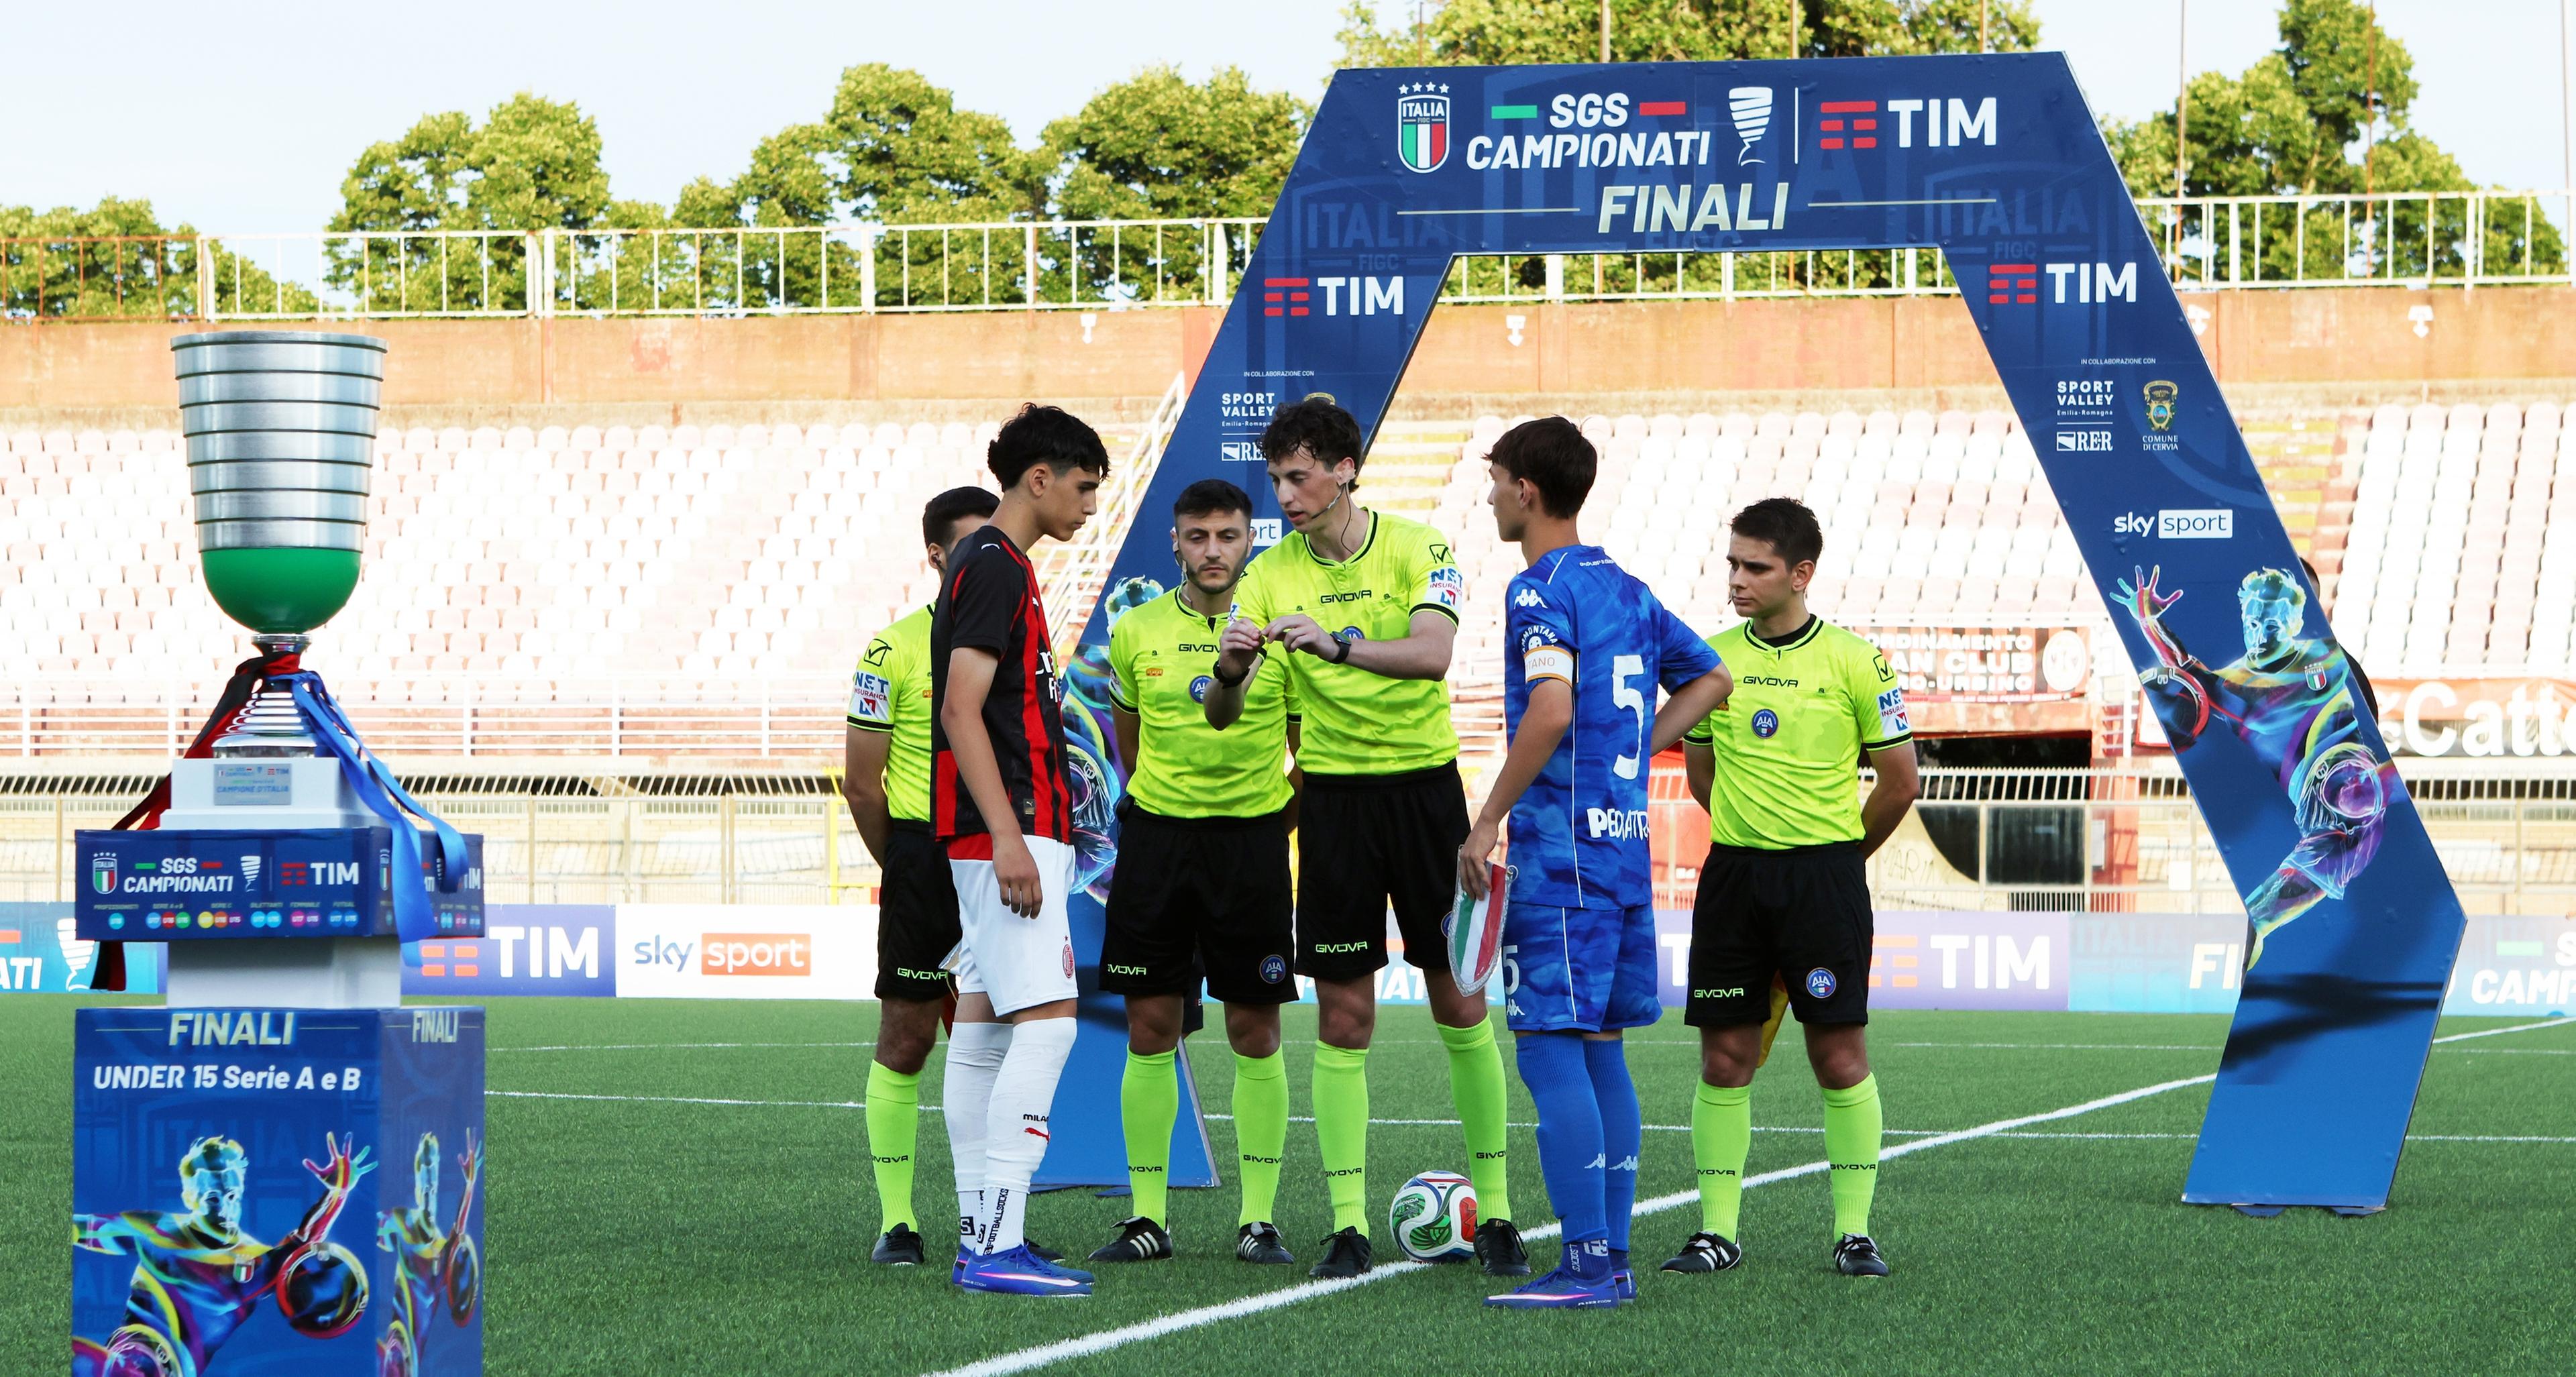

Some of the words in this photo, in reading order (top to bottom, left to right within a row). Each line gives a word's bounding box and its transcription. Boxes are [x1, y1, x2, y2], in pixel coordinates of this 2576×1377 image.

[1402, 102, 1445, 117] ITALIA
[1549, 93, 1629, 128] SGS
[1887, 97, 1997, 148] TIM
[1466, 131, 1711, 170] CAMPIONATI
[1597, 182, 1790, 233] FINALI
[2045, 262, 2137, 303] TIM
[1318, 276, 1404, 316] TIM
[1222, 392, 1275, 404] SPORT
[2057, 380, 2114, 393] SPORT
[1222, 406, 1275, 417] VALLEY
[2057, 394, 2114, 406] VALLEY
[1240, 442, 1267, 461] RE
[2114, 511, 2155, 537] sky
[2164, 514, 2227, 535] sport
[1320, 590, 1372, 604] GIVOVA
[1179, 644, 1220, 653] GIVOV
[1943, 651, 2033, 674] CLUB
[855, 671, 889, 694] NET
[1195, 683, 1206, 692] AI
[1743, 676, 1799, 687] GIVOVA
[1879, 687, 1900, 710] NE
[1612, 655, 1644, 780] 5
[1756, 716, 1774, 728] AIA
[161, 858, 197, 874] SGS
[310, 862, 359, 885] TIM
[123, 875, 234, 893] CAMPIONATI
[489, 926, 598, 978] TIM
[634, 934, 694, 973] sky
[707, 938, 804, 972] sport
[1316, 941, 1368, 953] GIVOVA
[897, 967, 948, 981] GIVOVA
[1108, 964, 1146, 975] VOVA
[1266, 962, 1283, 973] AIA
[1503, 945, 1519, 995] 5
[1930, 936, 2051, 991] TIM
[2189, 943, 2245, 989] FI
[1812, 975, 1831, 987] AIA
[1694, 988, 1744, 999] GIVOVA
[168, 1012, 295, 1046] FINALI
[412, 1011, 460, 1044] FINALI
[93, 1065, 186, 1089] UNDER
[192, 1065, 217, 1087] 15
[223, 1065, 290, 1089] Serie
[294, 1066, 315, 1089] A
[321, 1073, 337, 1090] e
[341, 1068, 361, 1091] B
